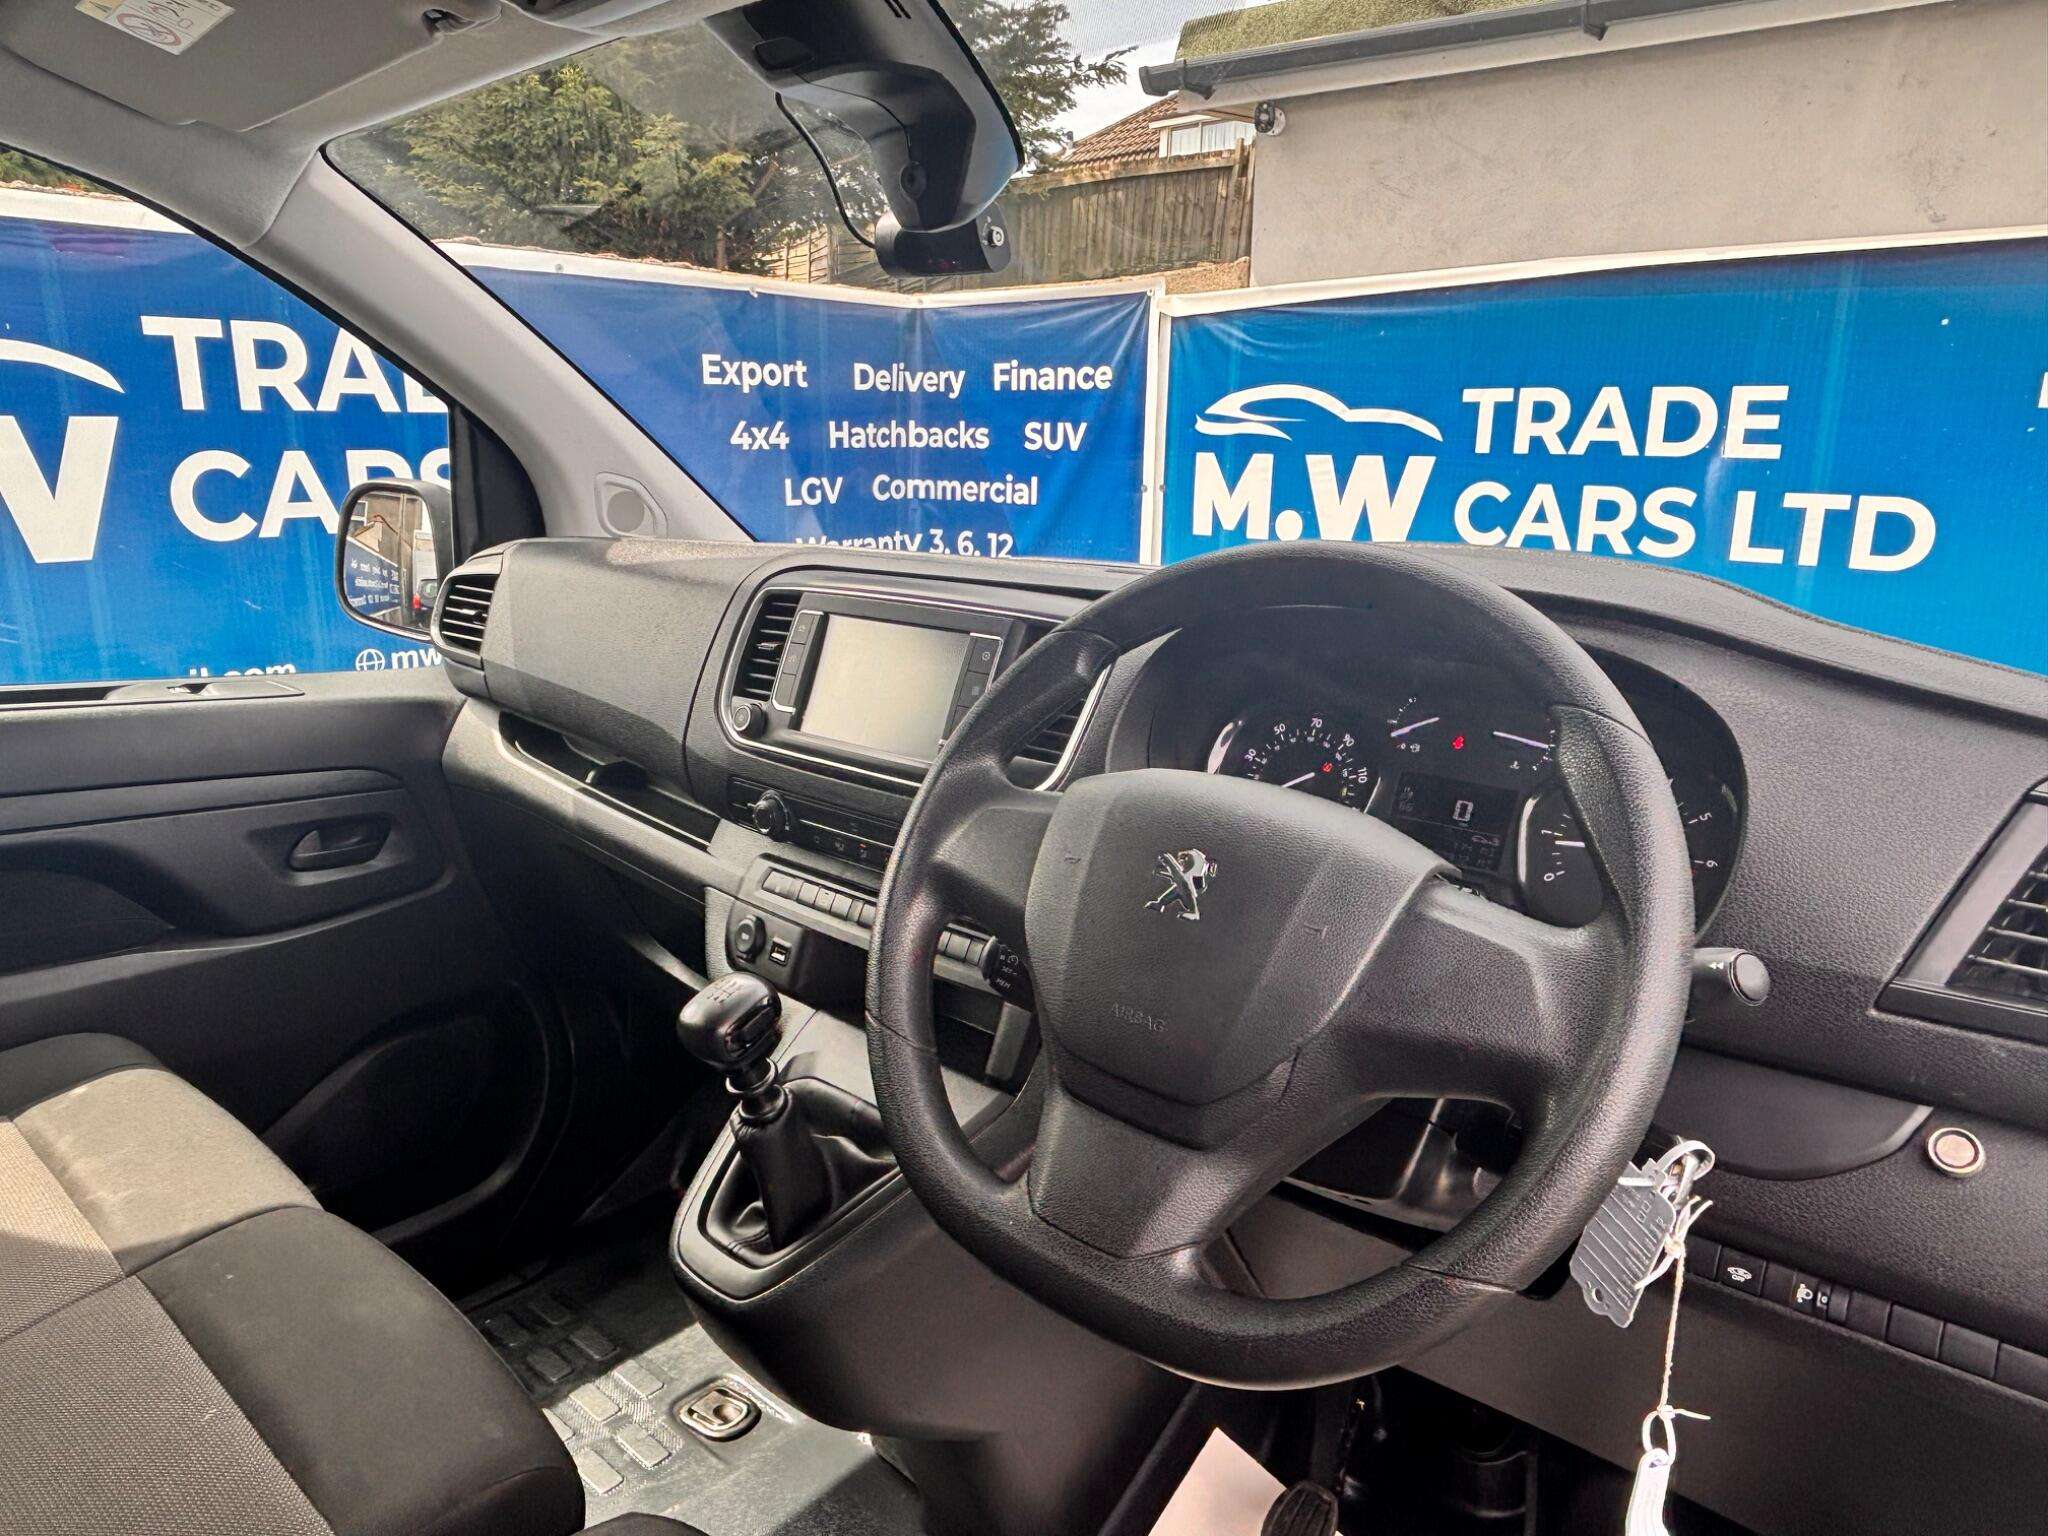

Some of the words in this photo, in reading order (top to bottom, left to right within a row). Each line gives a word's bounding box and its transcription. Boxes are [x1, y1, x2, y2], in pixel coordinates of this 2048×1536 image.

[701, 353, 808, 394] Export
[853, 362, 966, 399] Delivery
[993, 359, 1113, 391] Finance
[729, 420, 790, 451] 4x4
[828, 419, 990, 450] Hatchbacks
[1023, 421, 1088, 452] SUV
[1462, 385, 1790, 460] TRADE
[784, 476, 844, 507] LGV
[872, 473, 1038, 506] Commercial
[987, 532, 1014, 558] 12
[1454, 481, 1699, 559] CARS
[1728, 490, 1937, 572] LTD
